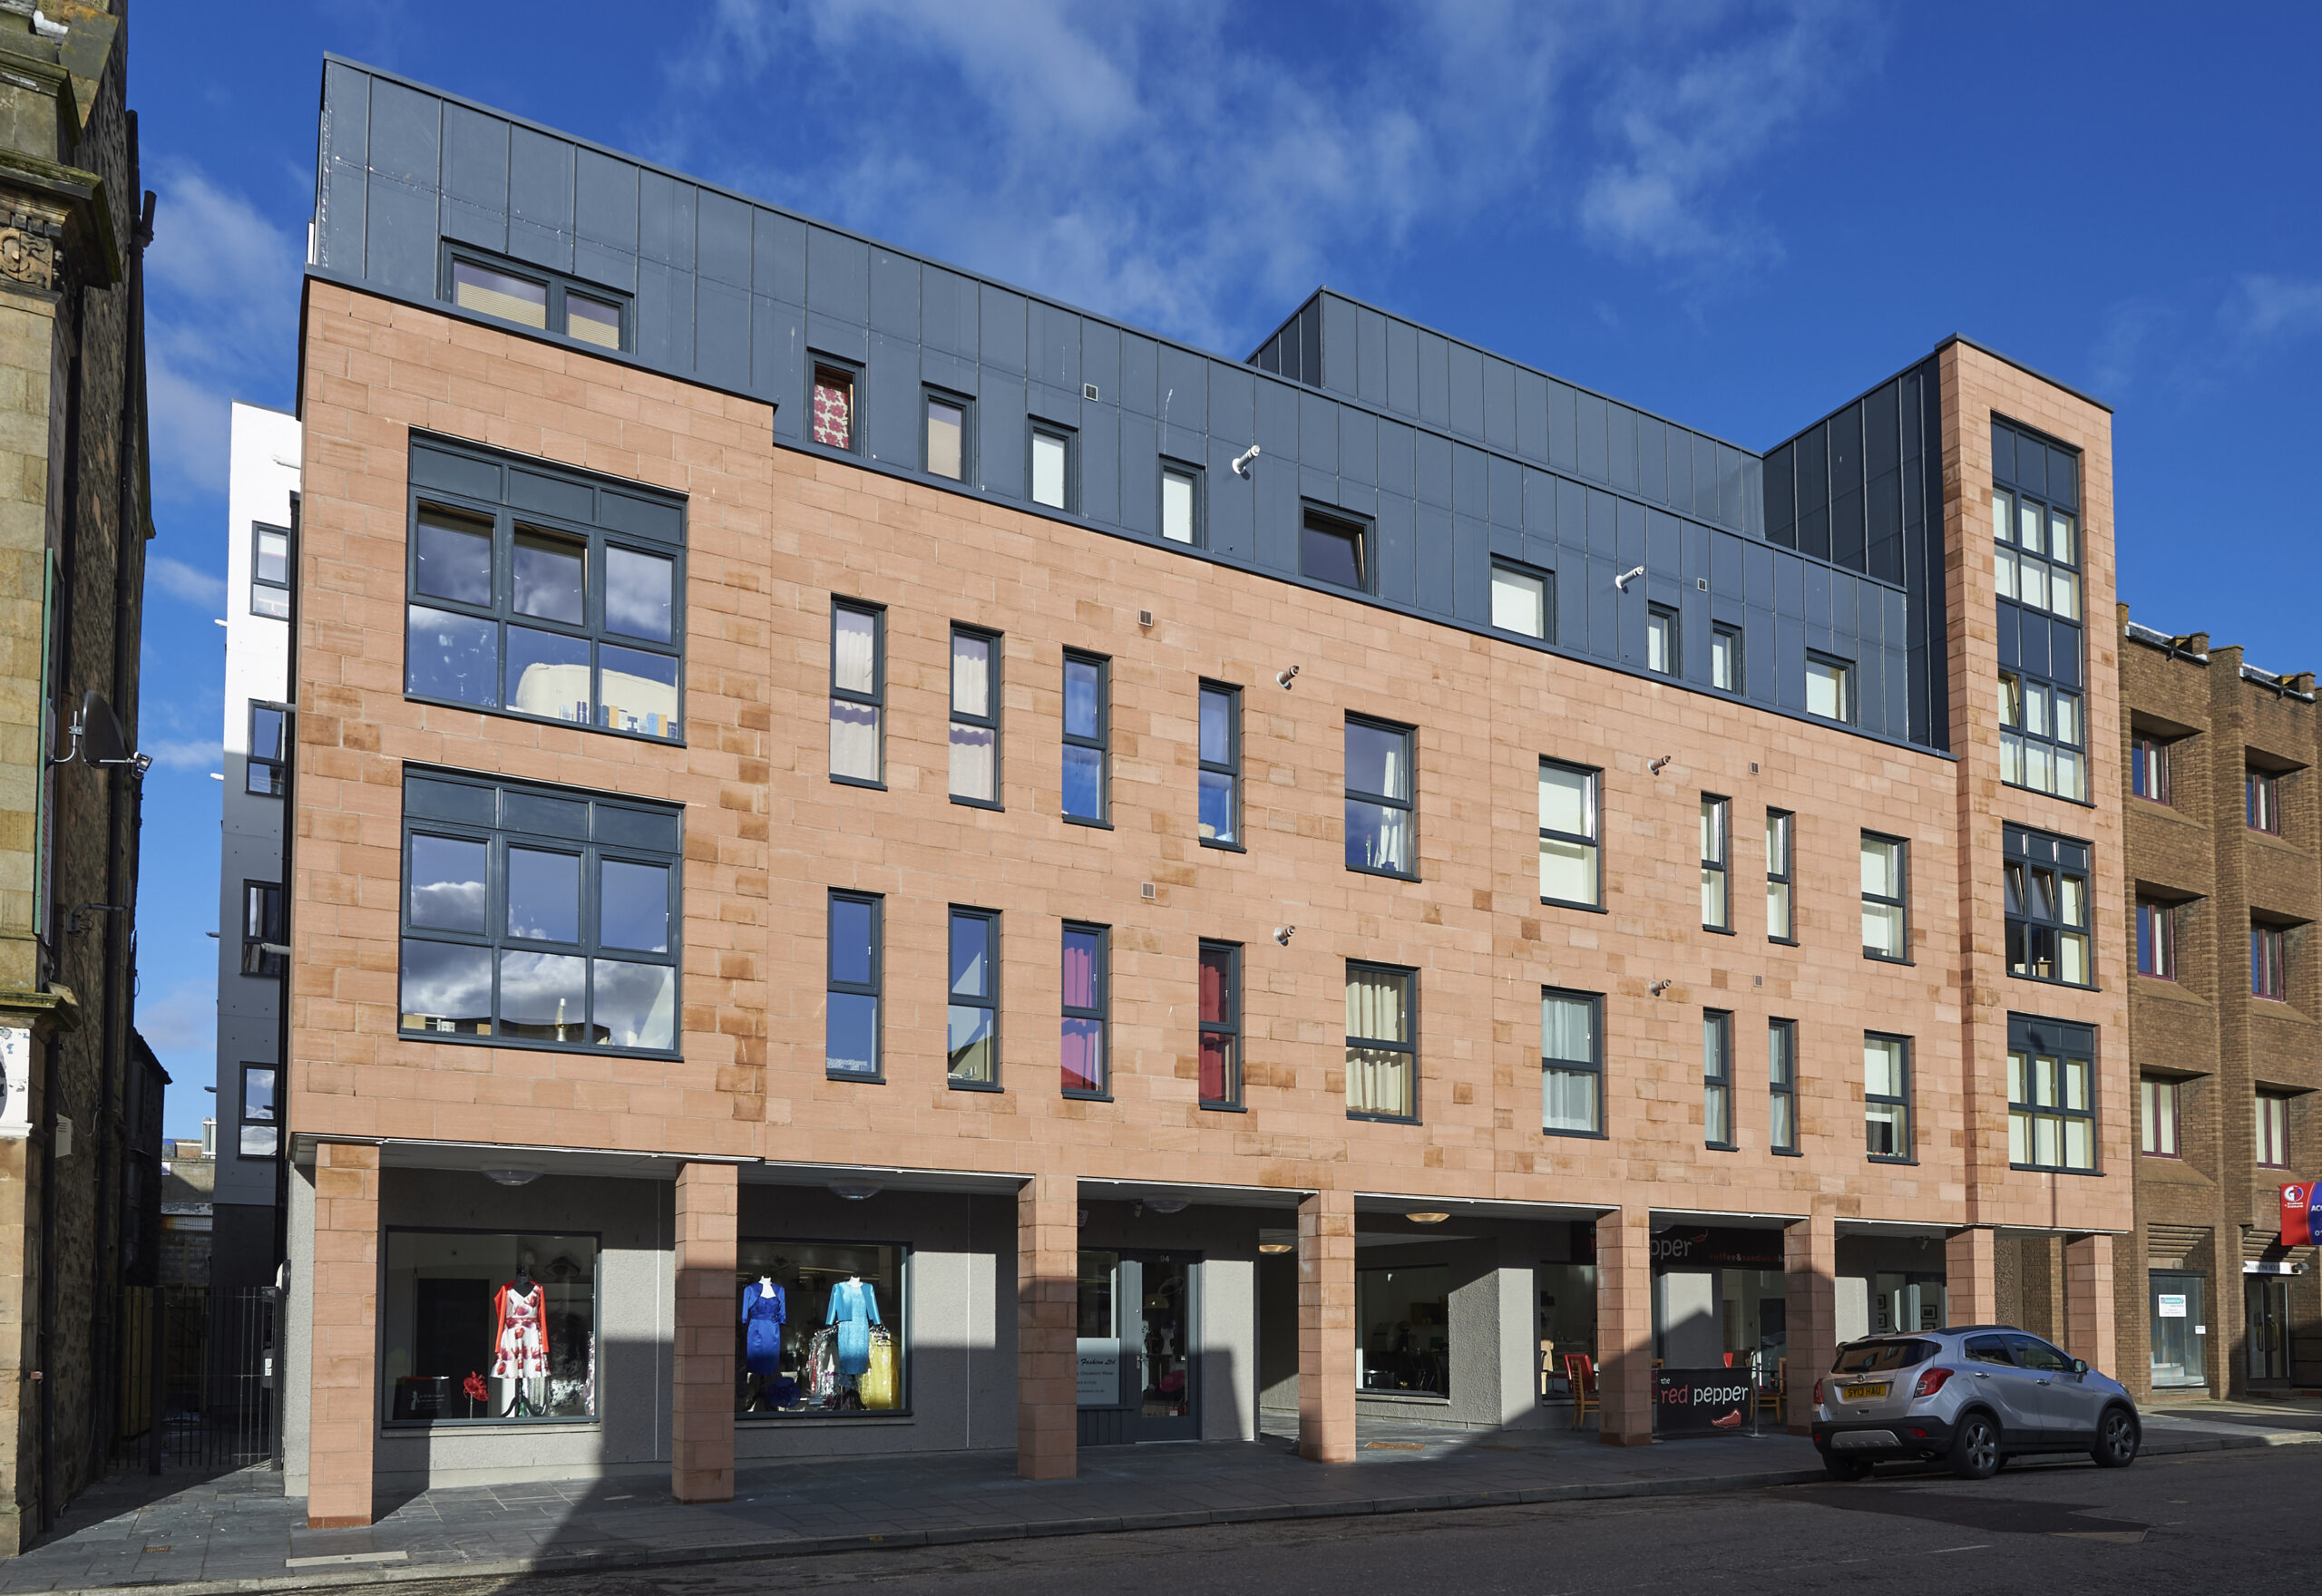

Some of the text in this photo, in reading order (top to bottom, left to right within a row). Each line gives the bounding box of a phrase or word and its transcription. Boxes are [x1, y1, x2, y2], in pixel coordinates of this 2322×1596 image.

[1160, 1254, 1170, 1263] 94
[1661, 1384, 1749, 1406] red pepper
